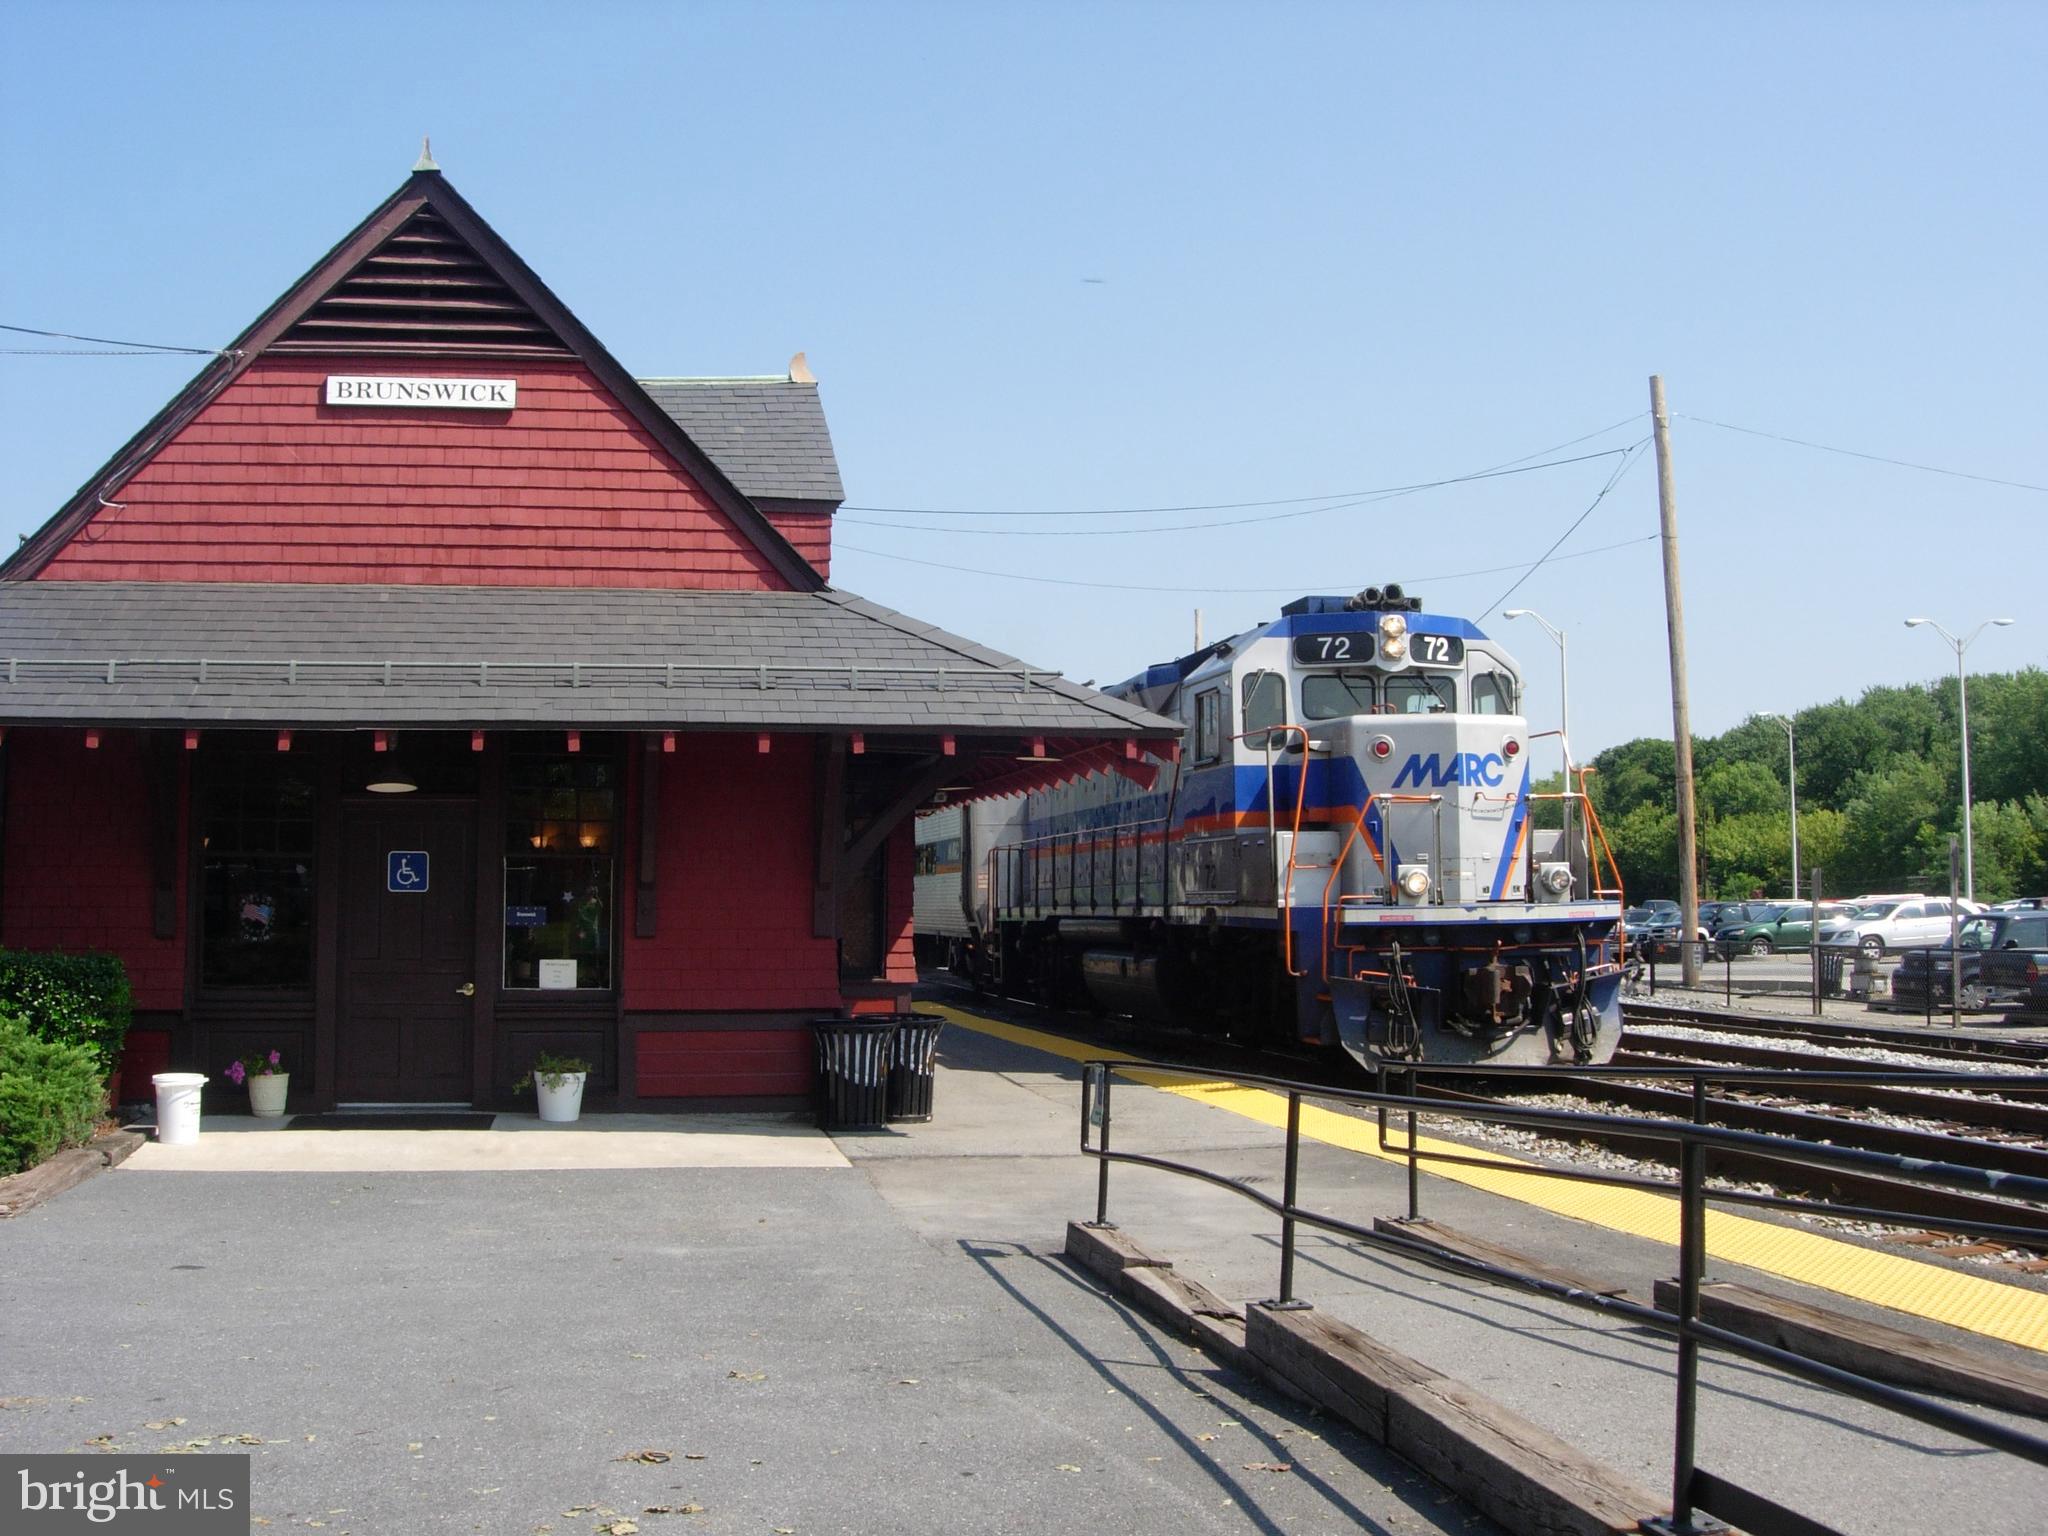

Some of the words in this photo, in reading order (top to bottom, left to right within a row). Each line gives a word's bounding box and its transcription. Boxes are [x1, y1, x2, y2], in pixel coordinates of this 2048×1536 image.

[336, 381, 508, 402] BRUNSWICK
[1317, 636, 1351, 660] 72
[1424, 636, 1449, 662] 72
[1391, 752, 1504, 789] MARC
